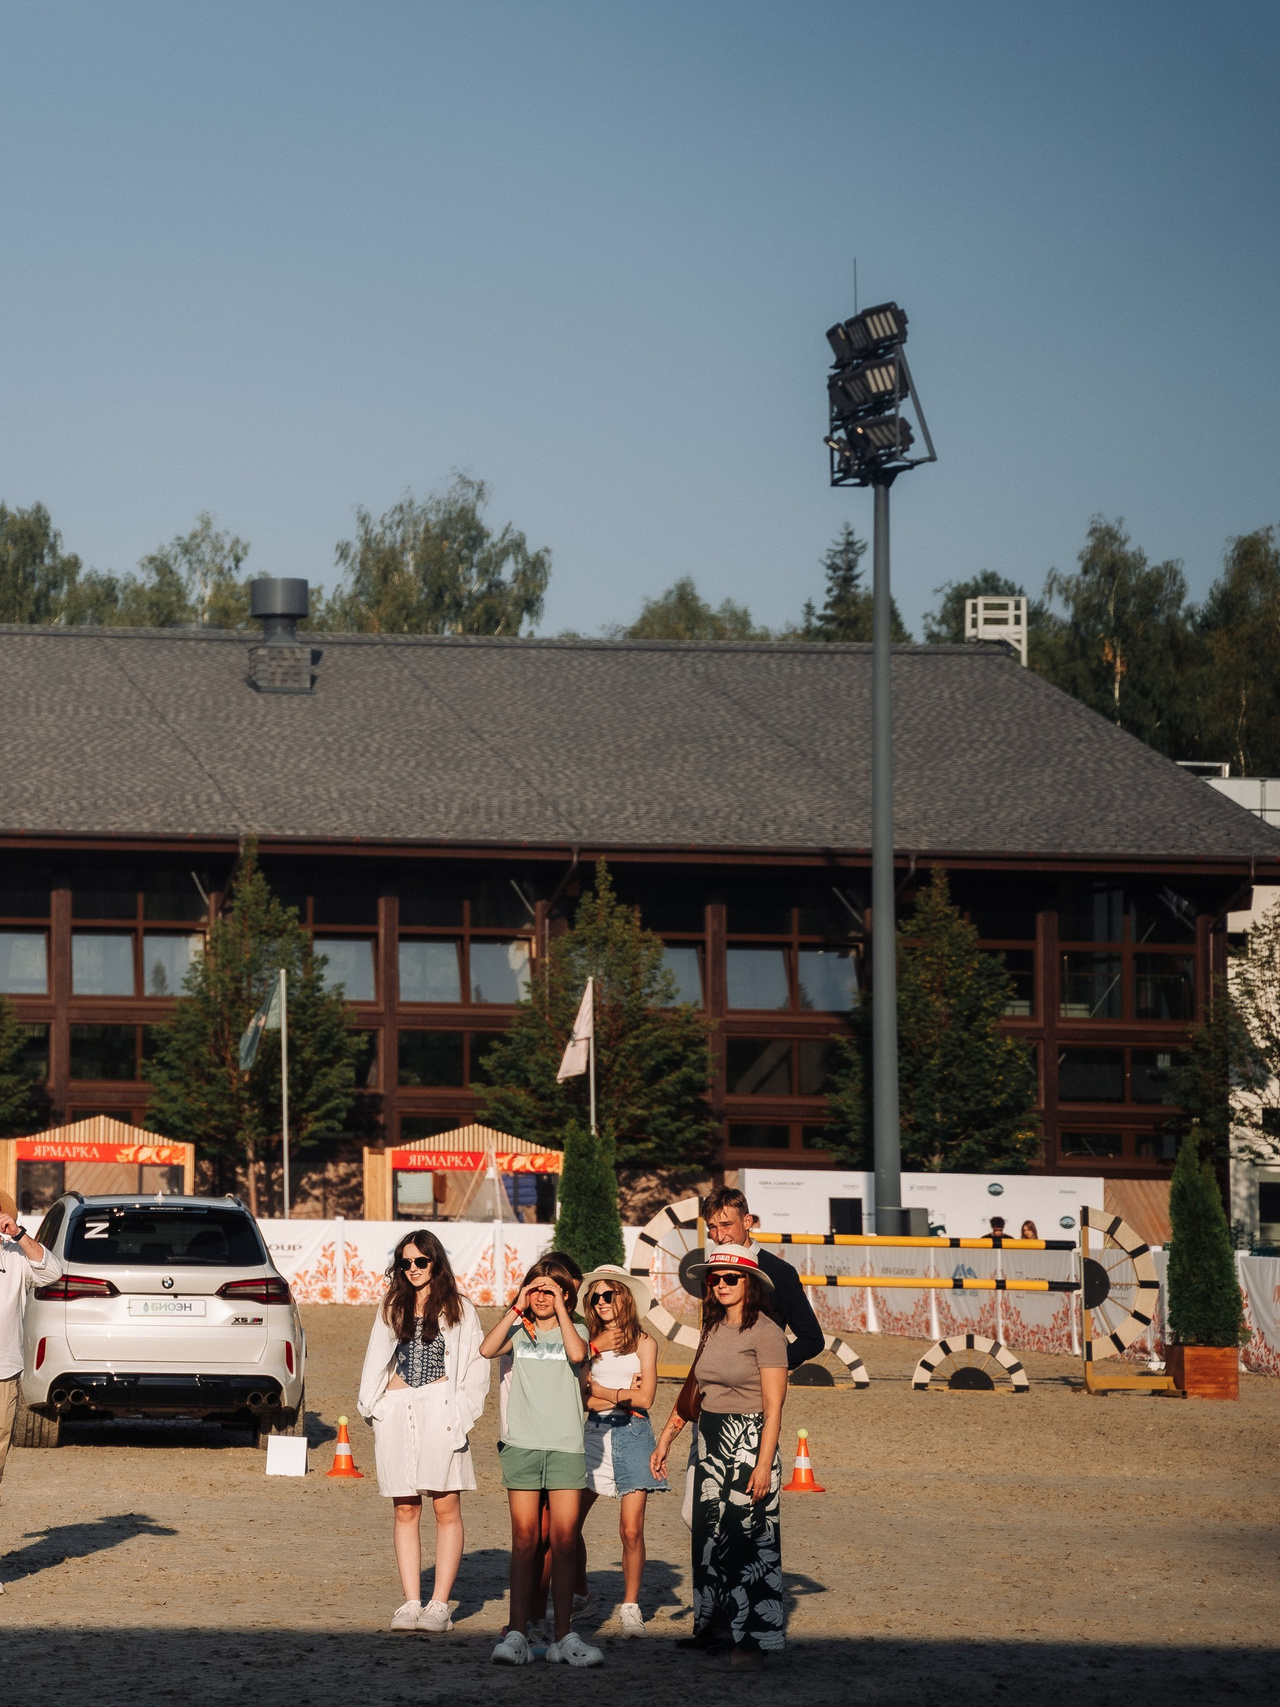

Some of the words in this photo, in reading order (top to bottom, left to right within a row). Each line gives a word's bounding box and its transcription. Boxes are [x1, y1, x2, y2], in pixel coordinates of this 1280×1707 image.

[33, 1145, 99, 1158] ЯРМАРКА
[407, 1154, 474, 1167] ЯРМАРКА
[150, 1302, 193, 1312] БИОЭН
